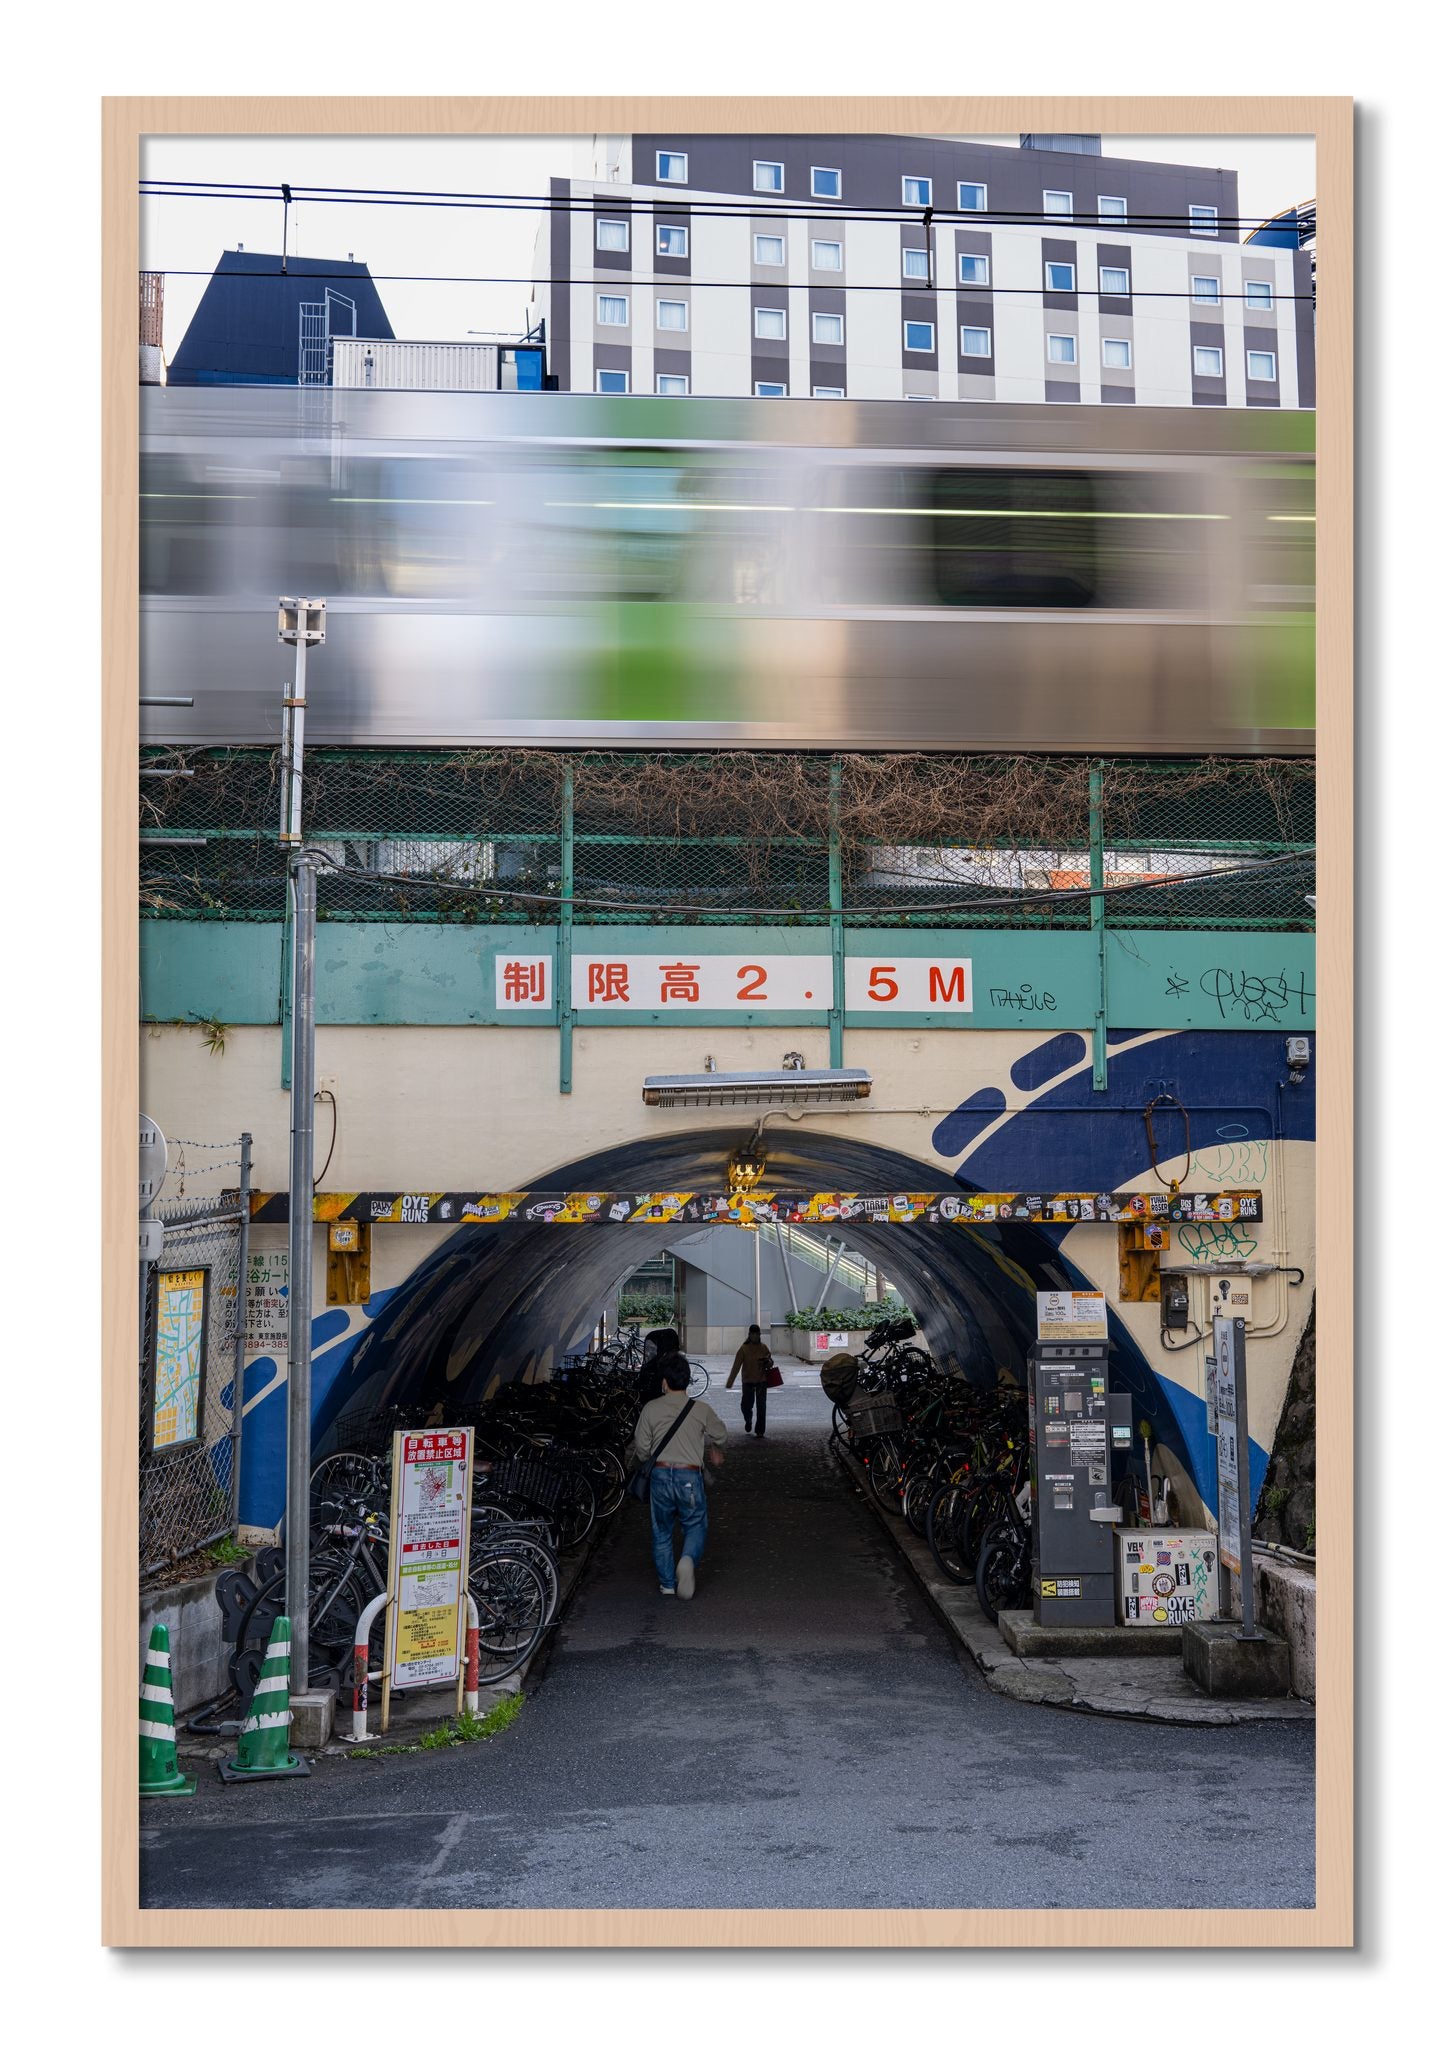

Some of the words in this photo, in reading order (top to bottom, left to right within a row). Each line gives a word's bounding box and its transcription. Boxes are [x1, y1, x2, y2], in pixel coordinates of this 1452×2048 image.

[402, 1195, 430, 1209] OYE
[1240, 1198, 1257, 1207] OYE
[401, 1209, 429, 1223] RUNS
[1240, 1207, 1258, 1216] RUNS
[407, 1447, 463, 1461] 放置禁止区域
[1167, 1597, 1195, 1610] OYE
[1168, 1610, 1196, 1625] RUNS
